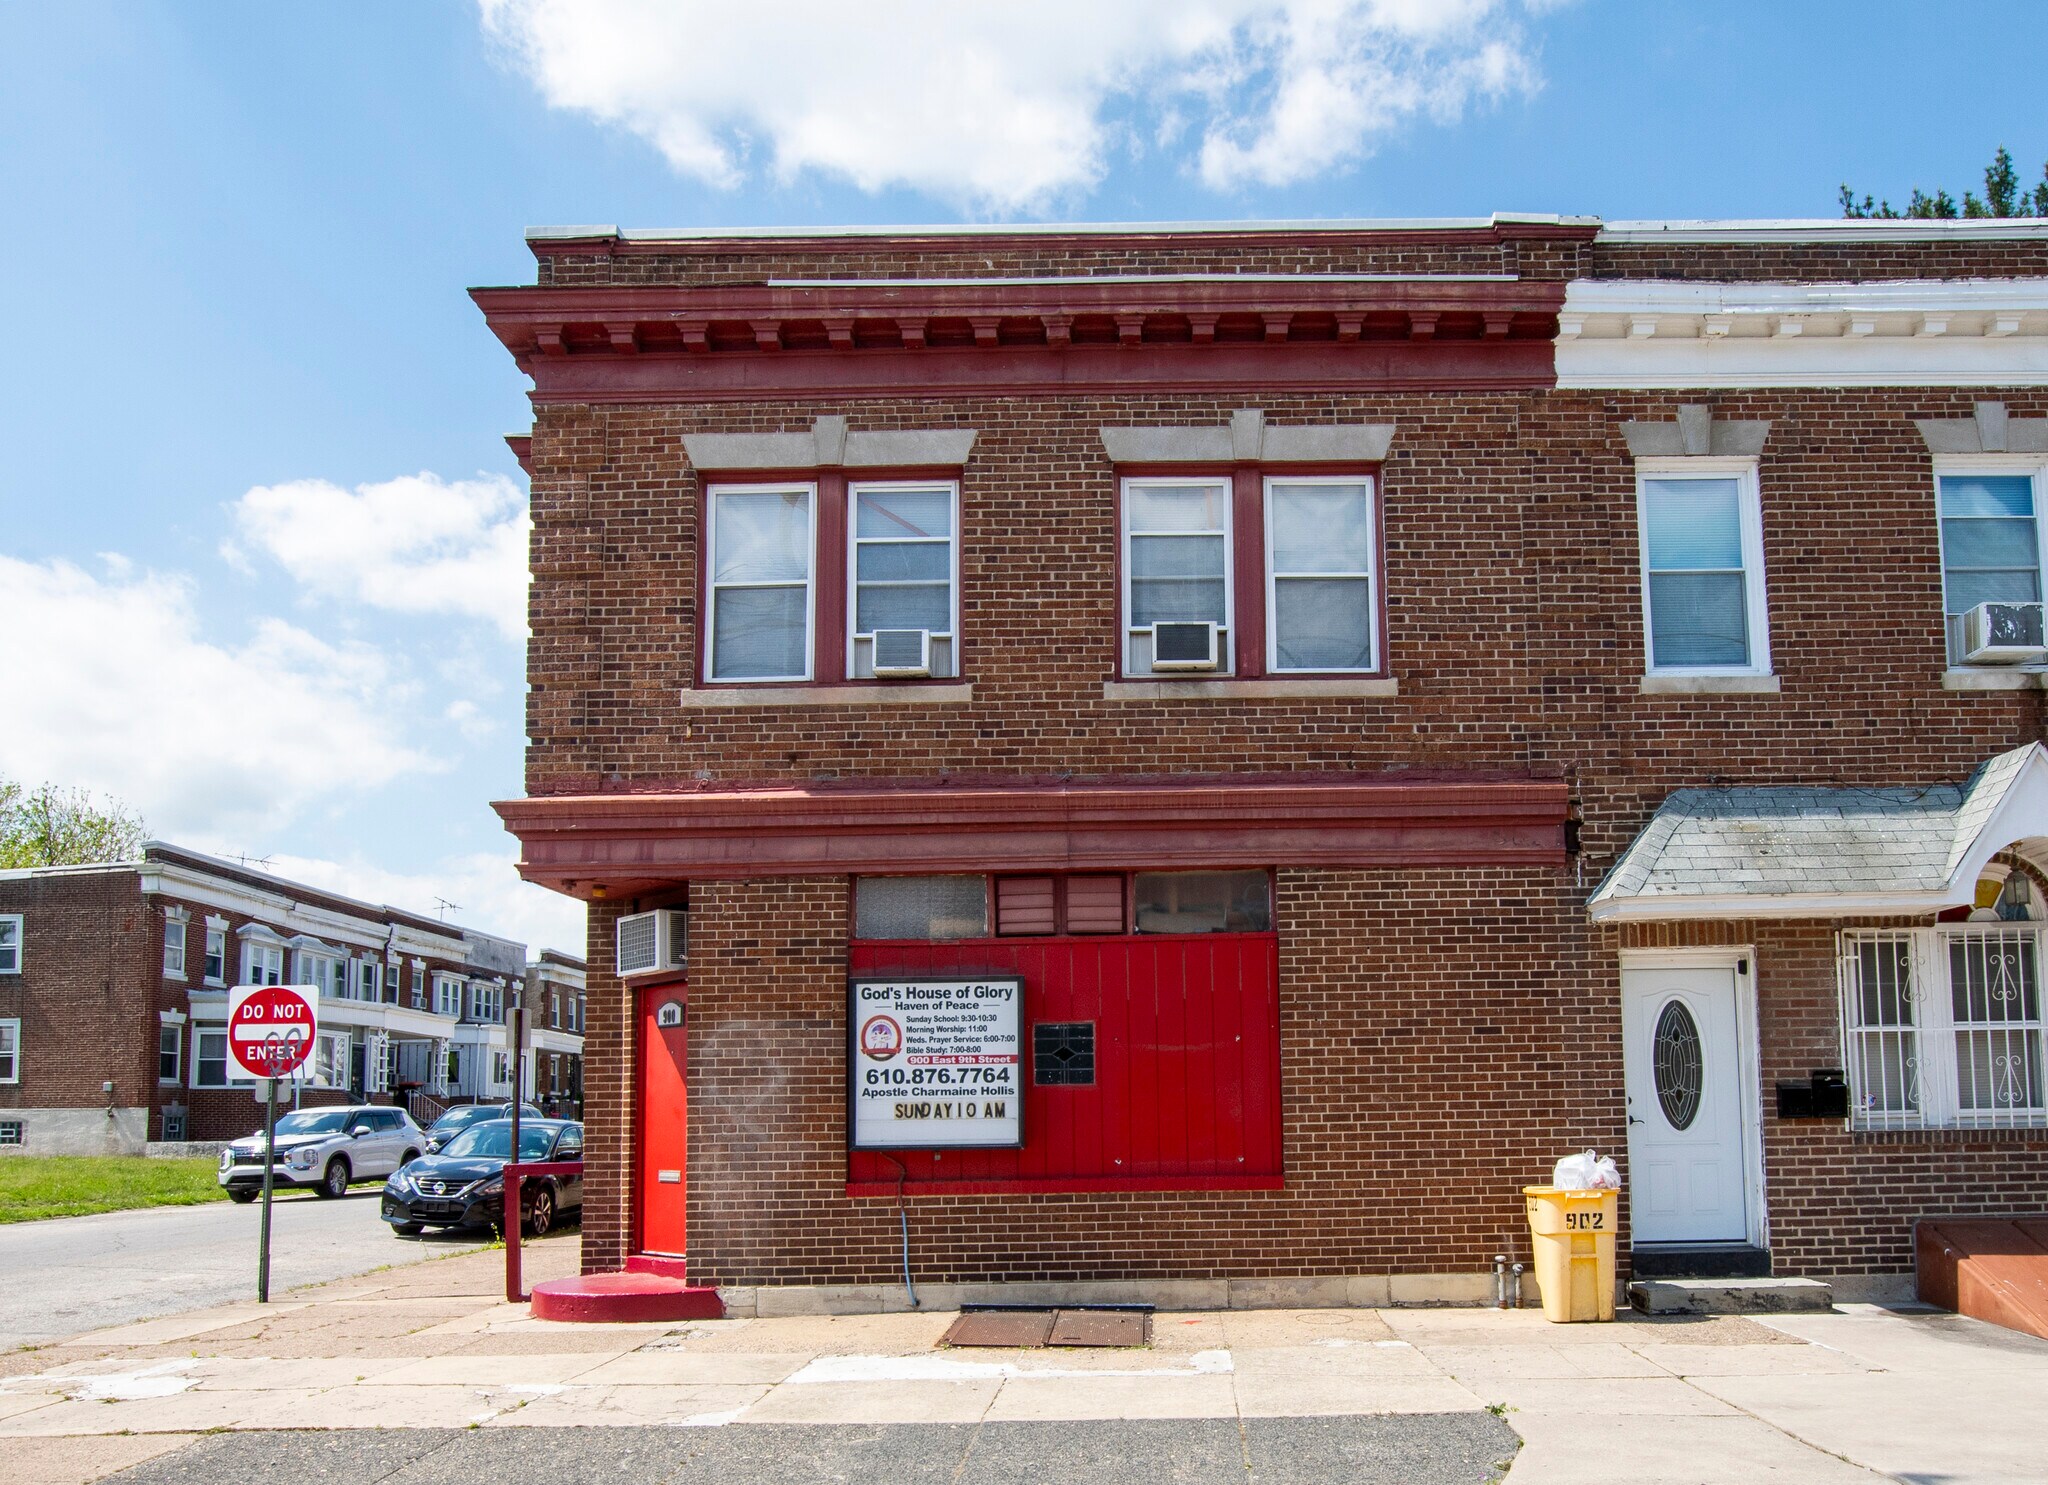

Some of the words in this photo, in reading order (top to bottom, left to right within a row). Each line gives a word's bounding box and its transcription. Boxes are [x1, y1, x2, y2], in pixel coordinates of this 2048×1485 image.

[861, 987, 901, 1000] God's
[906, 986, 951, 999] House
[956, 986, 970, 998] of
[974, 985, 1013, 1001] Glory
[243, 1005, 264, 1019] DO
[273, 1004, 304, 1018] NOT
[895, 1002, 929, 1011] Haven
[932, 1001, 943, 1010] of
[946, 1001, 979, 1010] Peace
[663, 1009, 676, 1023] 900
[906, 1016, 932, 1024] Sunday
[906, 1026, 935, 1034] Morning
[936, 1025, 967, 1033] Worship:
[929, 1036, 952, 1044] Prayer
[247, 1046, 296, 1060] ENTER
[926, 1046, 948, 1055] Study:
[910, 1056, 930, 1064] 900
[978, 1055, 1011, 1063] Street
[866, 1067, 1010, 1084] 610.876.7764
[862, 1087, 908, 1098] Apostle
[911, 1087, 977, 1096] Charmaine
[981, 1086, 1015, 1095] Hollis
[895, 1103, 952, 1118] SUNDAY
[984, 1102, 1006, 1117] AM
[1566, 1213, 1603, 1229] 902
